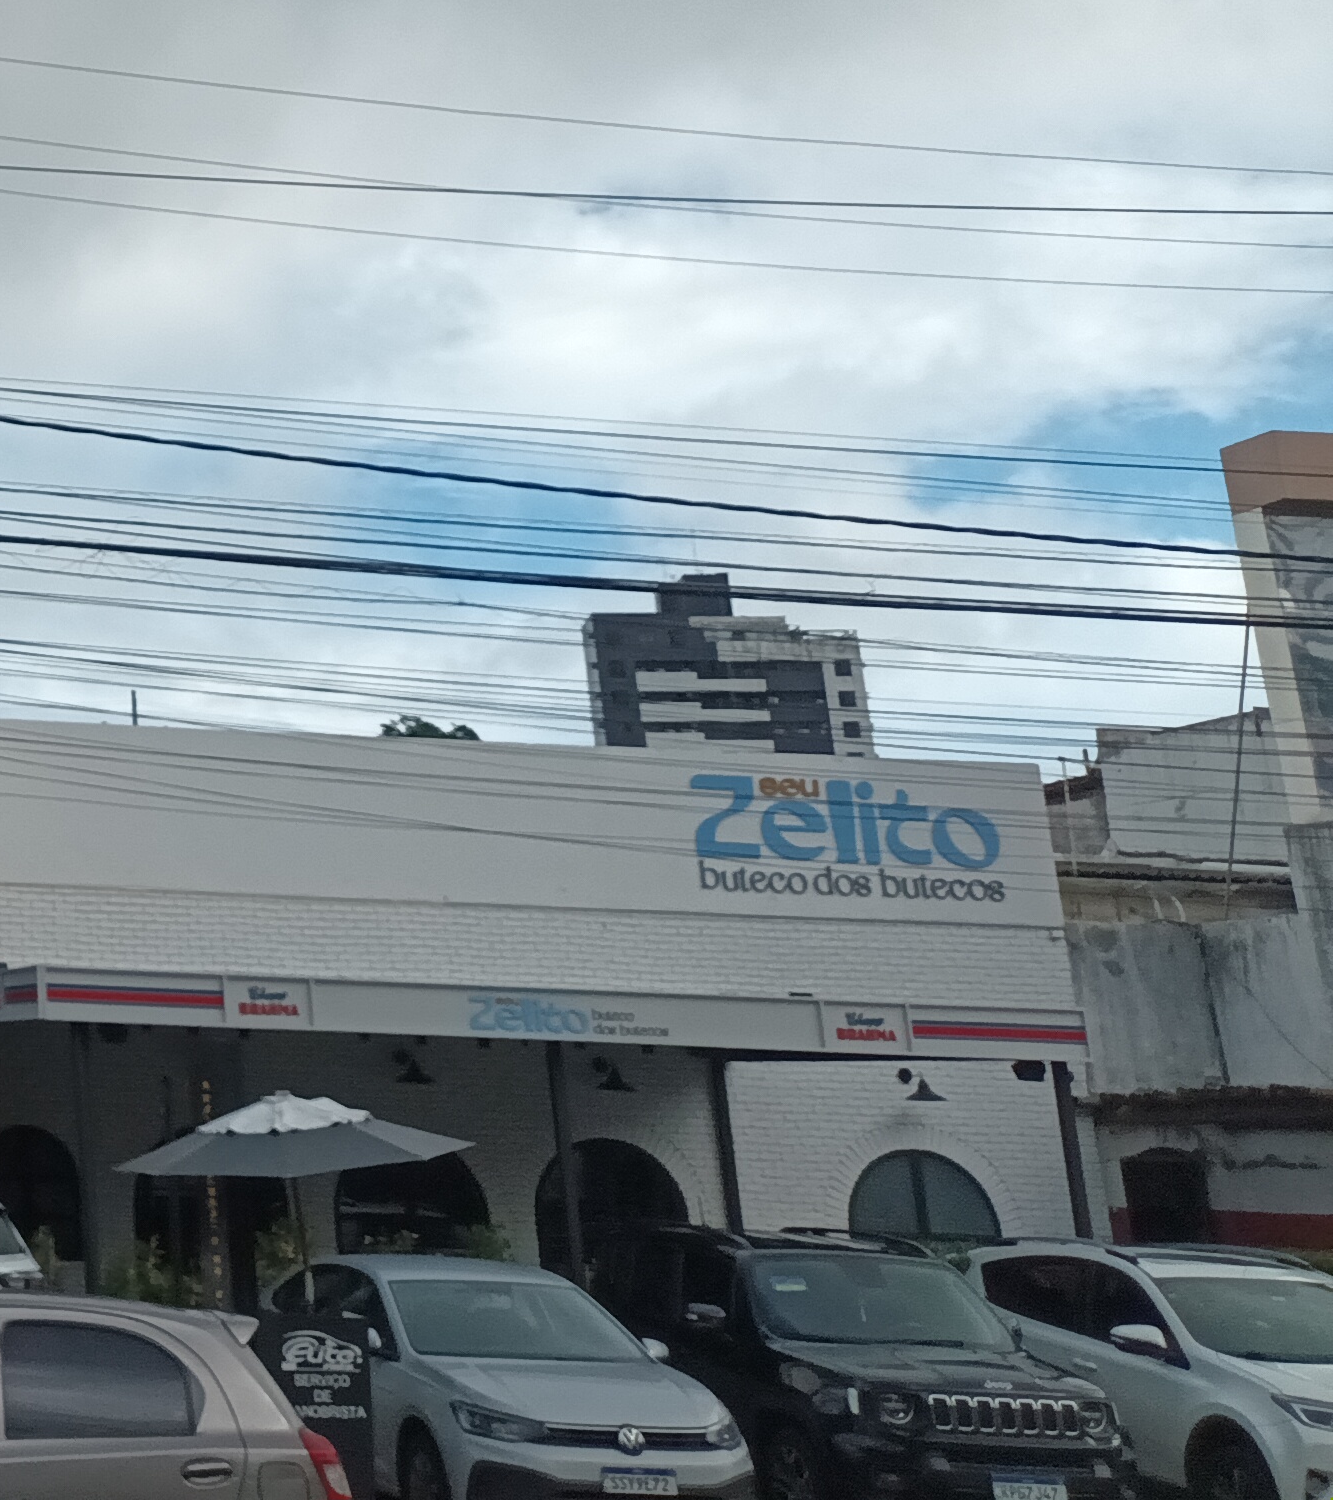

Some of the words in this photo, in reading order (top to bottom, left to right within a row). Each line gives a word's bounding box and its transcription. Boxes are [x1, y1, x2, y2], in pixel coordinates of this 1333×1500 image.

[758, 776, 821, 798] seu
[689, 773, 1001, 869] Zelito
[698, 860, 809, 894] buteco
[812, 866, 873, 898] dos
[879, 868, 1006, 903] butecos
[467, 995, 590, 1035] Zelito
[313, 1389, 334, 1403] DE
